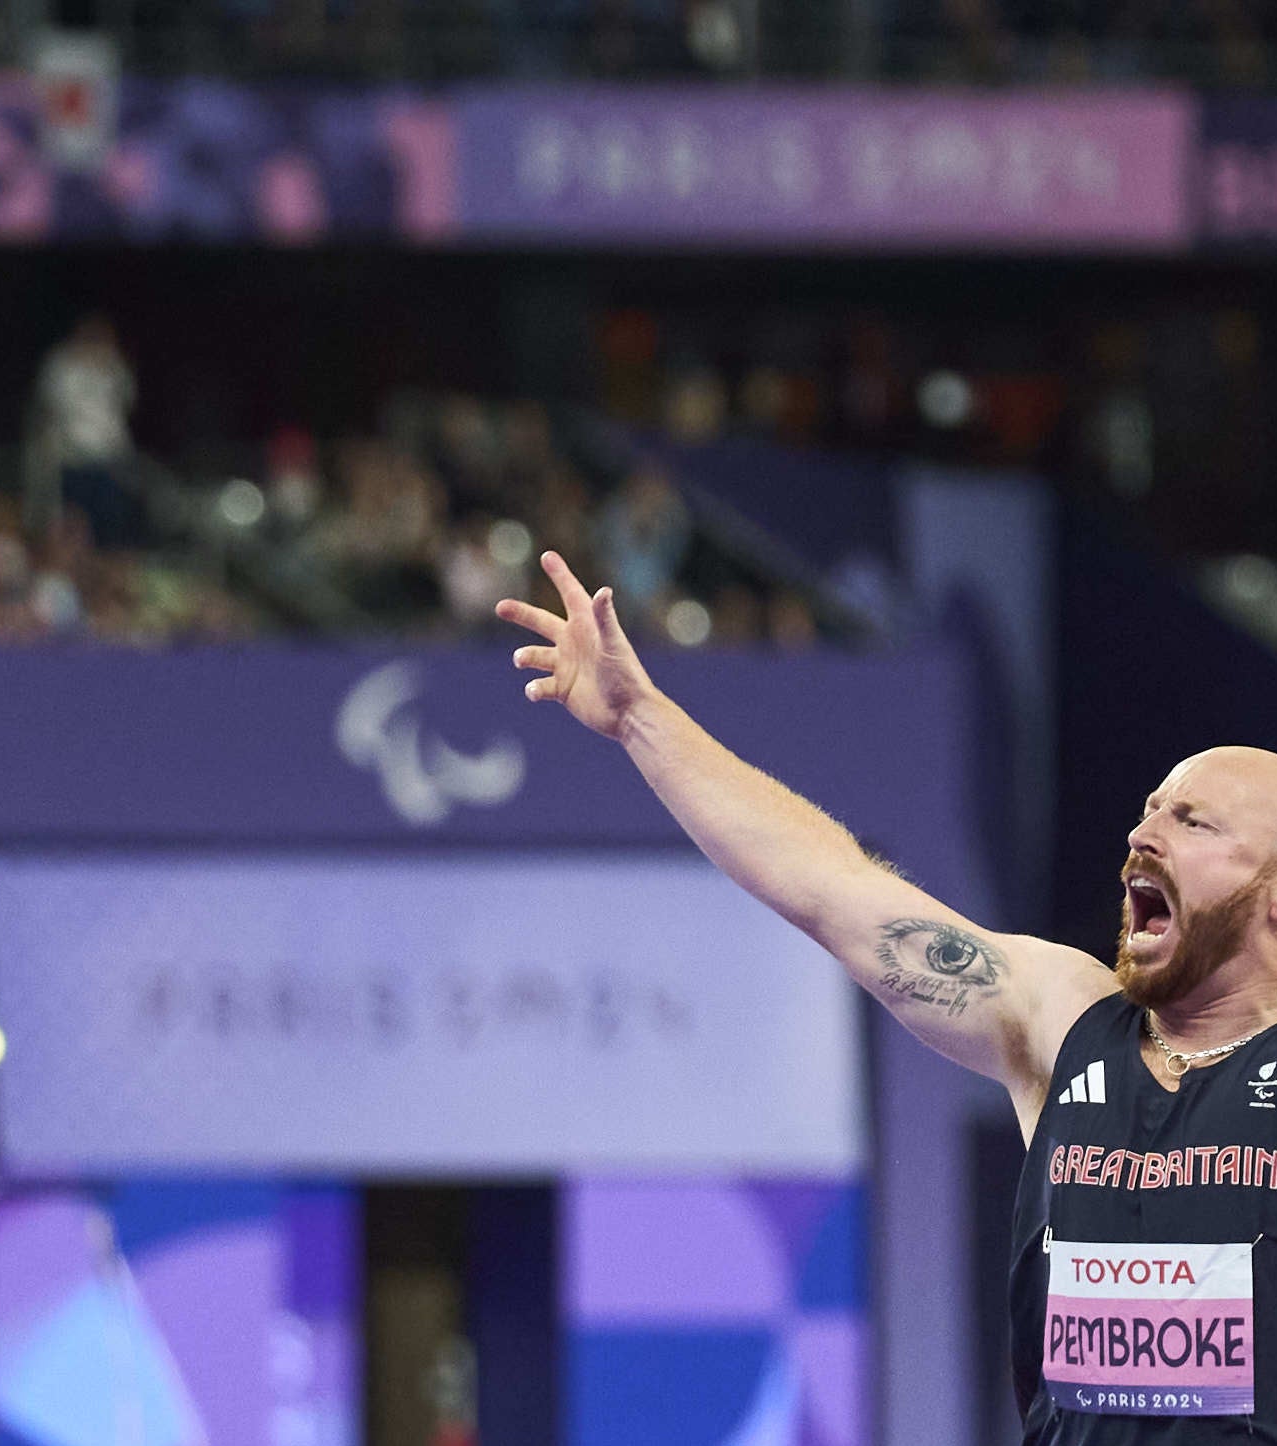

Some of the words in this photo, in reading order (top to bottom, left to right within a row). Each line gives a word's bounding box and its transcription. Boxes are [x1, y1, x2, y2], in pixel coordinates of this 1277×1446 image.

[1071, 1257, 1196, 1285] TOYOTA
[1049, 1313, 1246, 1368] PEMBROKE
[1098, 1392, 1147, 1409] PARIS
[1152, 1393, 1203, 1410] 2024
